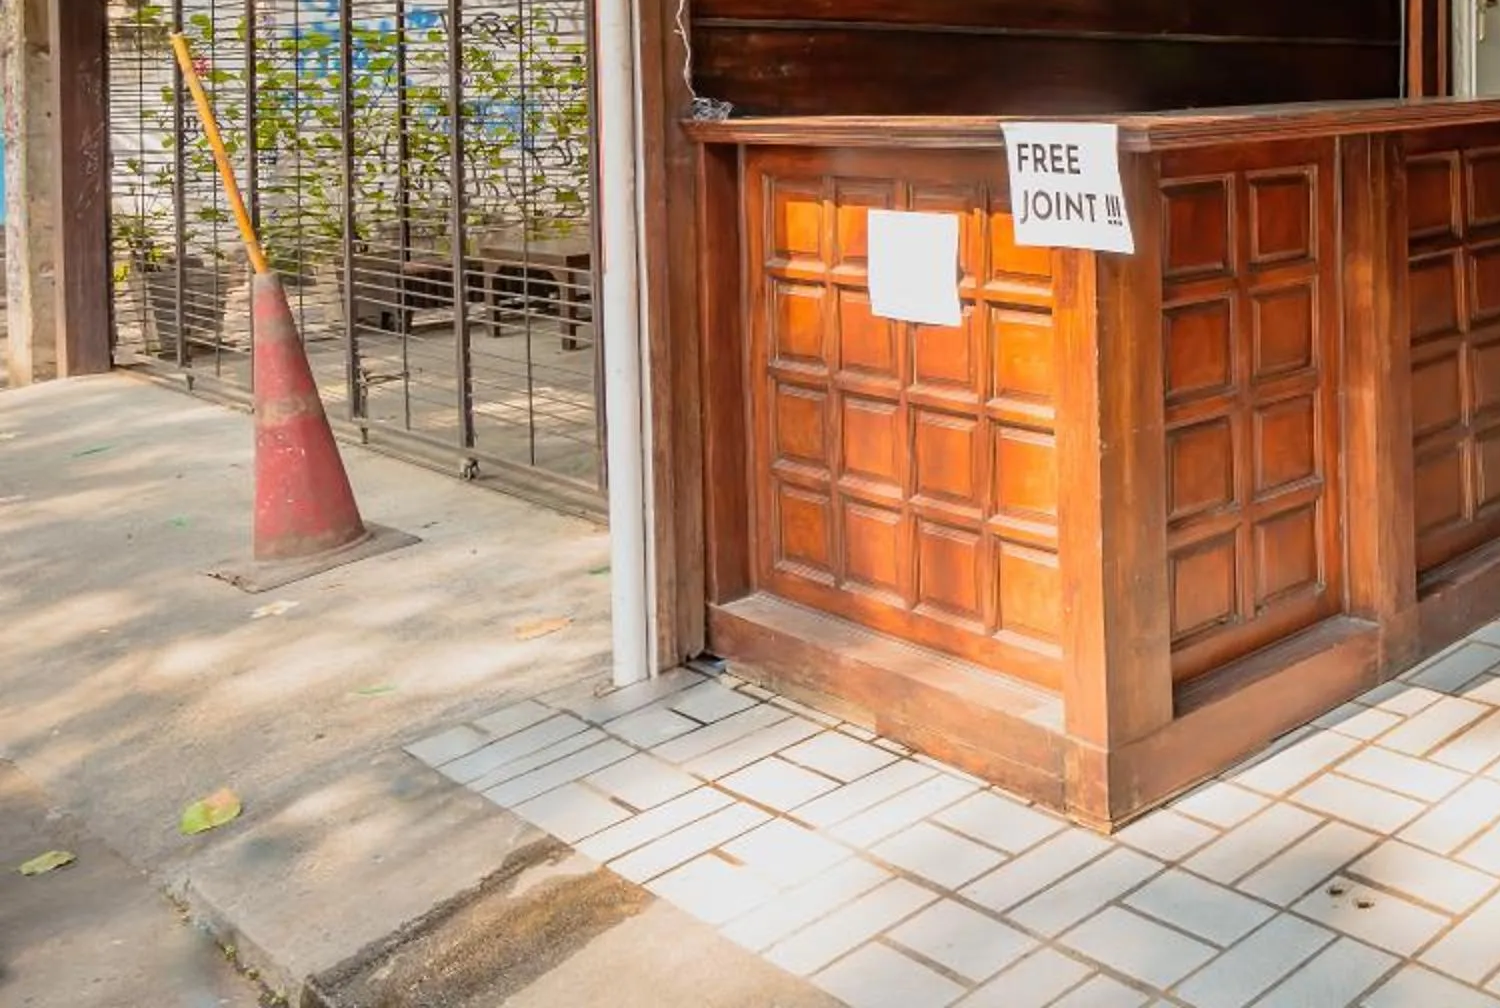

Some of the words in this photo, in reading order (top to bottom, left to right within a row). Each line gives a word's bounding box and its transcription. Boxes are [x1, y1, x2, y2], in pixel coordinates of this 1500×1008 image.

[1016, 143, 1081, 175] FREE
[1020, 190, 1097, 225] JOINT
[1105, 195, 1123, 227] !!!
